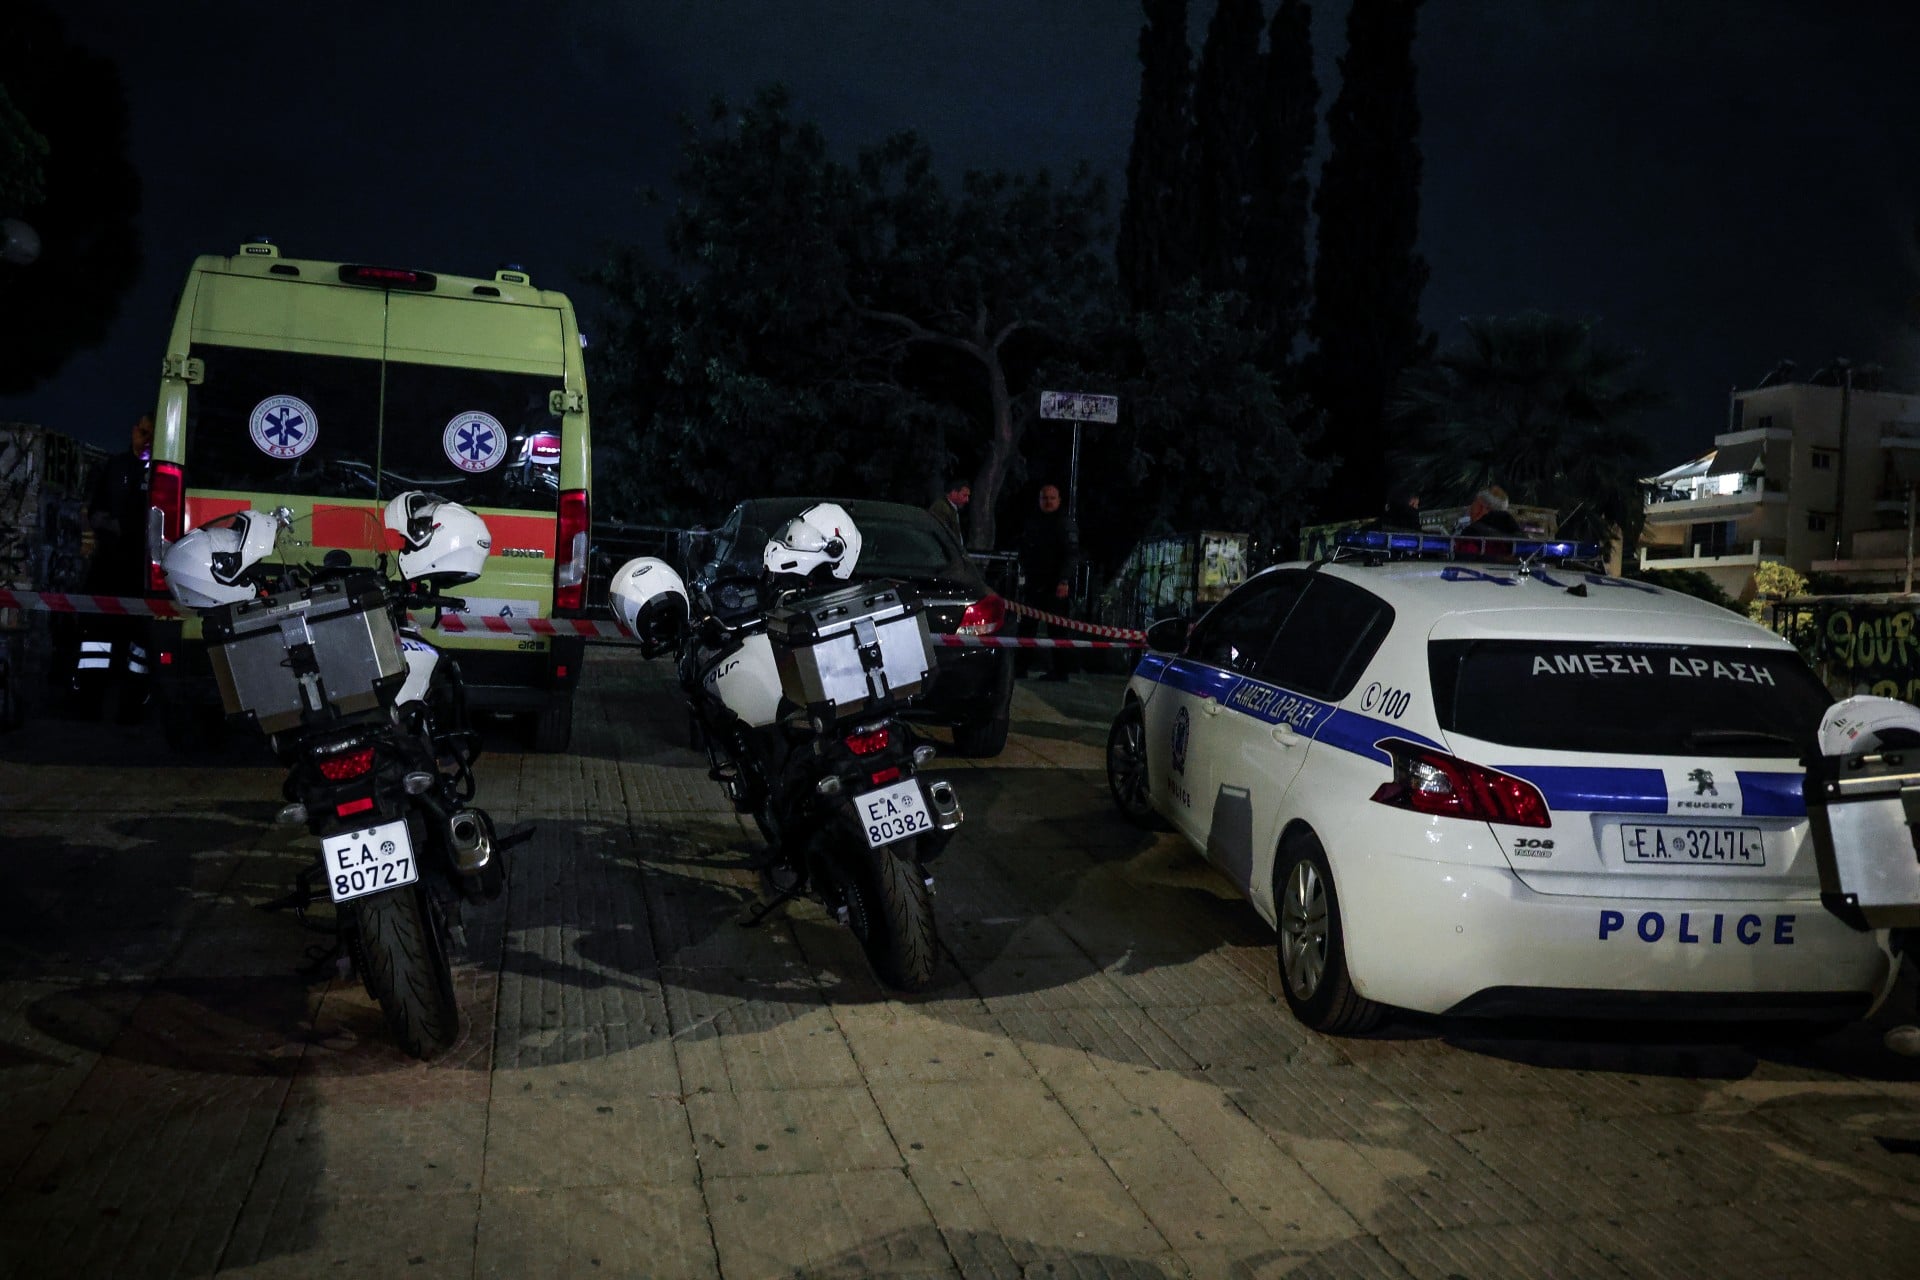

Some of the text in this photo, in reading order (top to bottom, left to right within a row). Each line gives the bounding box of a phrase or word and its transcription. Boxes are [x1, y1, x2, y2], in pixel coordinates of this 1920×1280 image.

[1532, 654, 1776, 687] ΑΜΕΣΗ ΔΡΑΣΗ
[1232, 682, 1323, 730] ΑΜΕΣΗ ΔΡΑΣΗ
[1378, 687, 1411, 720] 100
[1677, 800, 1735, 810] PEUGEOT
[868, 810, 929, 843] 80382
[1513, 838, 1554, 849] 308
[1686, 829, 1750, 861] 32474
[335, 857, 409, 895] 80727
[1598, 910, 1796, 945] POLICE
